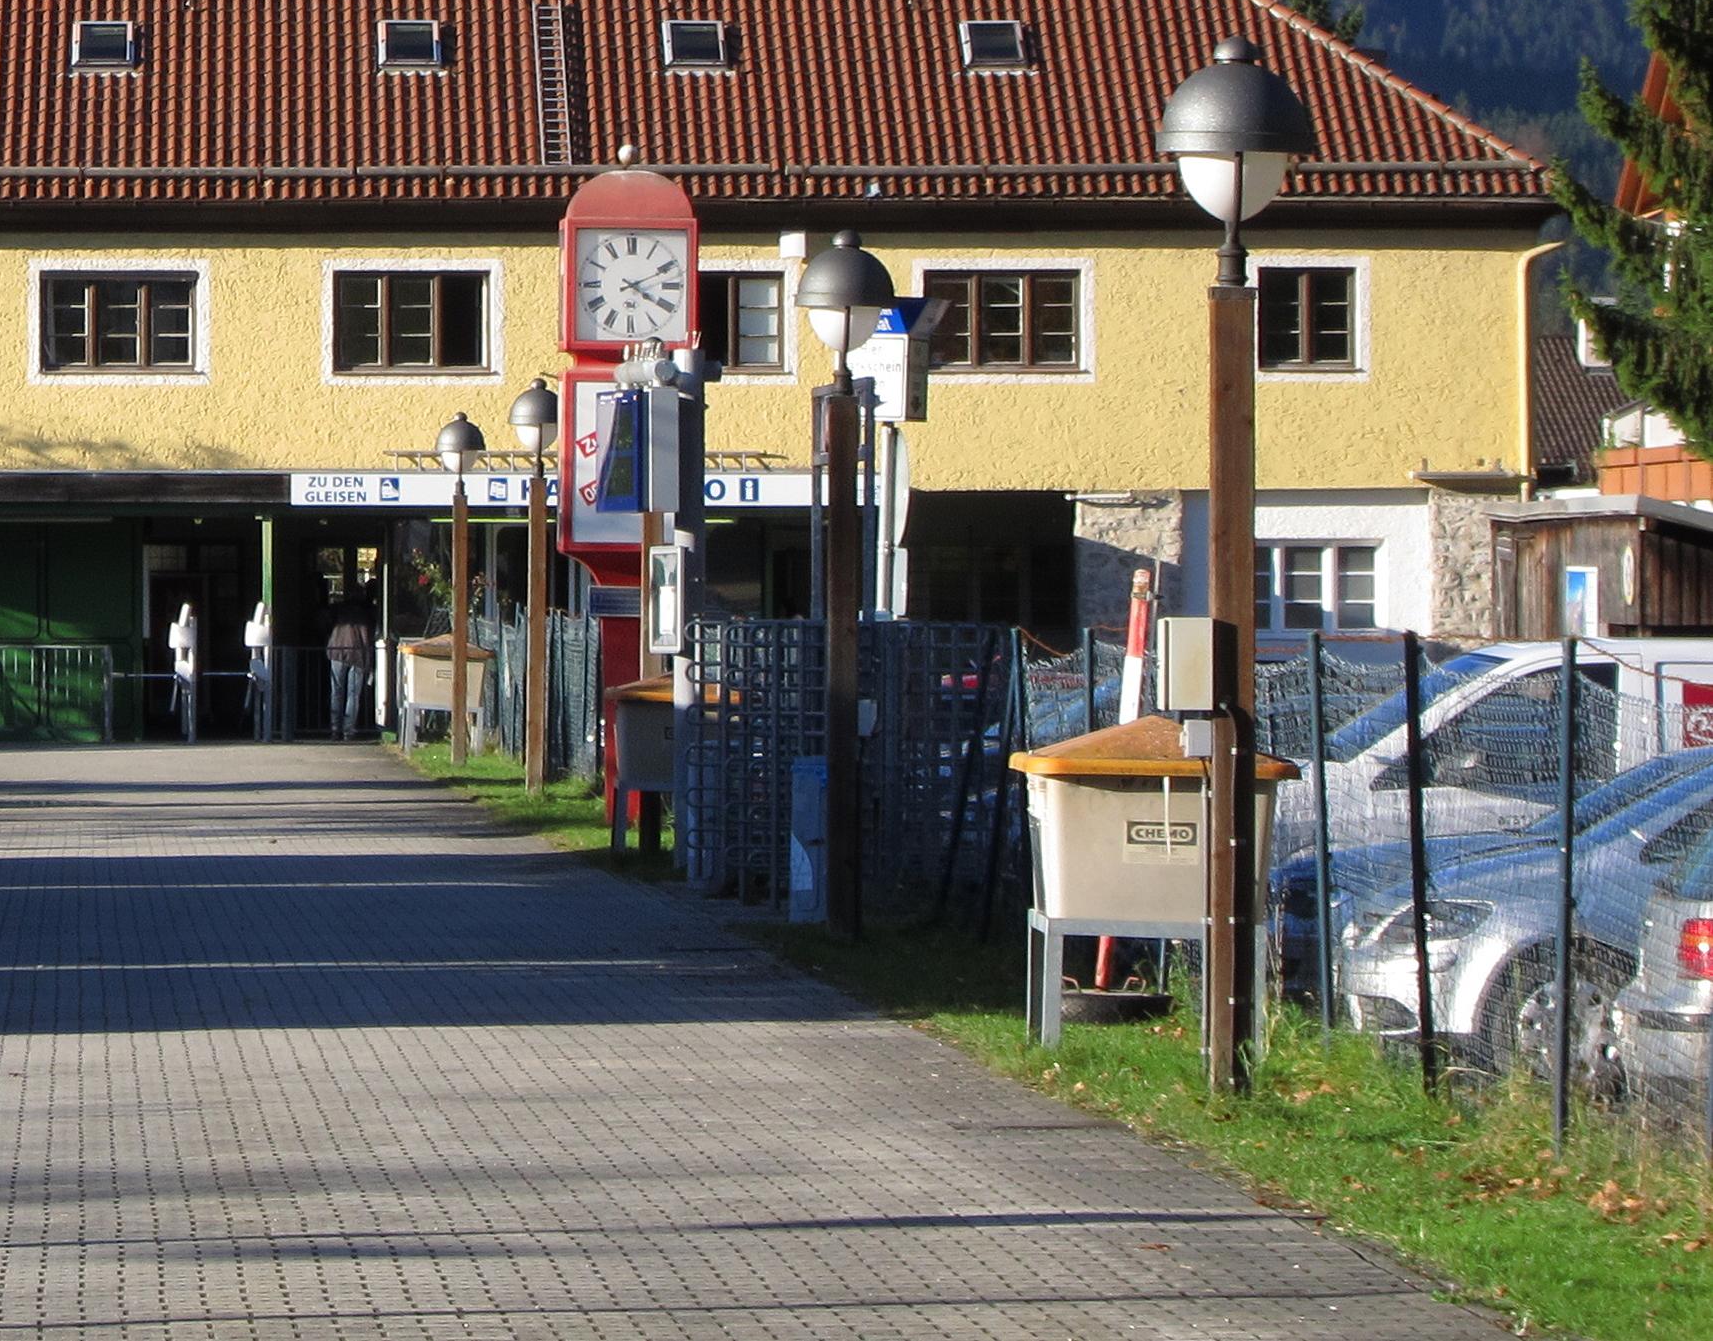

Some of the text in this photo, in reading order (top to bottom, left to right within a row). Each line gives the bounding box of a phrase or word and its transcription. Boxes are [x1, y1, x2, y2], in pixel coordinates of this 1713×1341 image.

[308, 476, 364, 488] ZU DEN
[304, 490, 367, 503] GLEISEN
[1134, 827, 1190, 840] CHEMO
